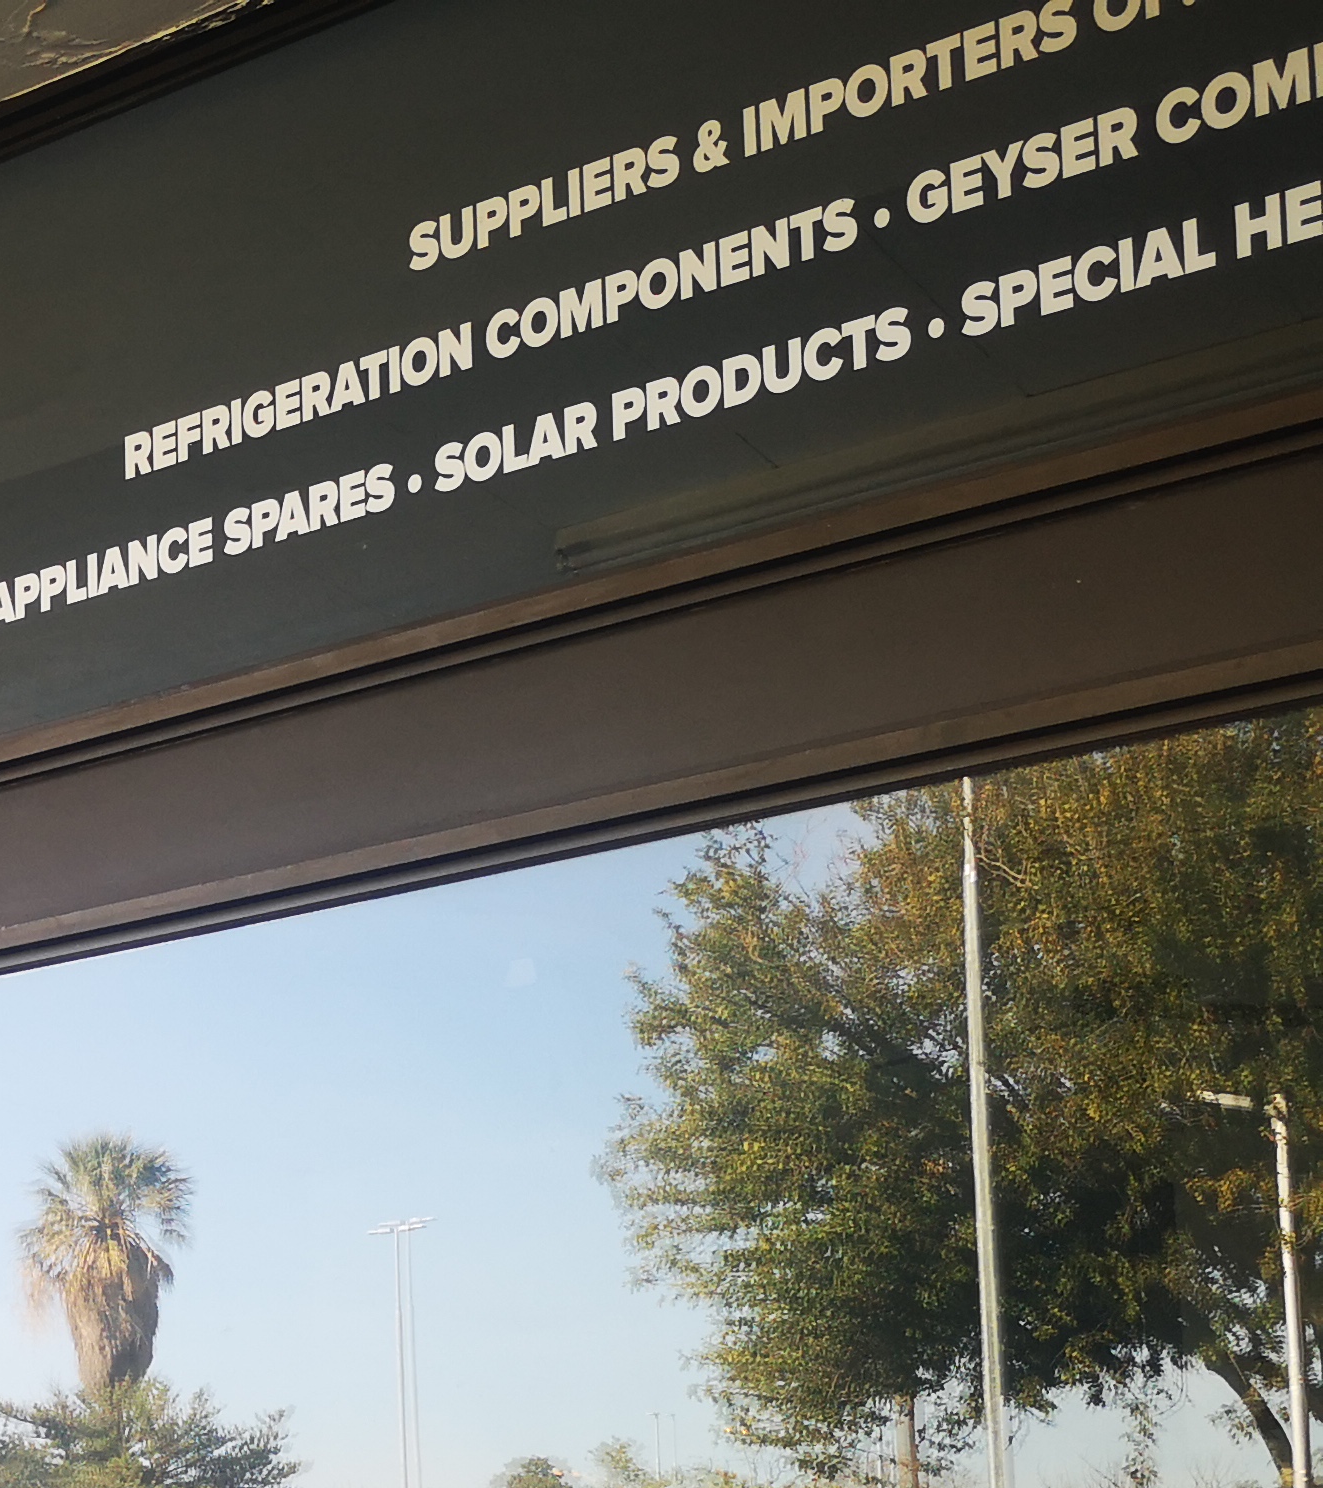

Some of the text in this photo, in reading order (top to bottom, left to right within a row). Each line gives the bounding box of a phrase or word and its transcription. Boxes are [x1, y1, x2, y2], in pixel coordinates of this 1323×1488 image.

[125, 41, 1323, 480] REFRIGERATION COMPONENTS GEYSER COM
[409, 135, 680, 270] SUPPLIERS
[693, 121, 728, 173] &
[744, 0, 1077, 156] IMPORTERS
[224, 465, 395, 558] SPARES
[435, 403, 597, 493] SOLAR
[612, 307, 911, 441] PRODUCTS
[961, 218, 1217, 338] SPECIAL
[1234, 179, 1323, 259] HE
